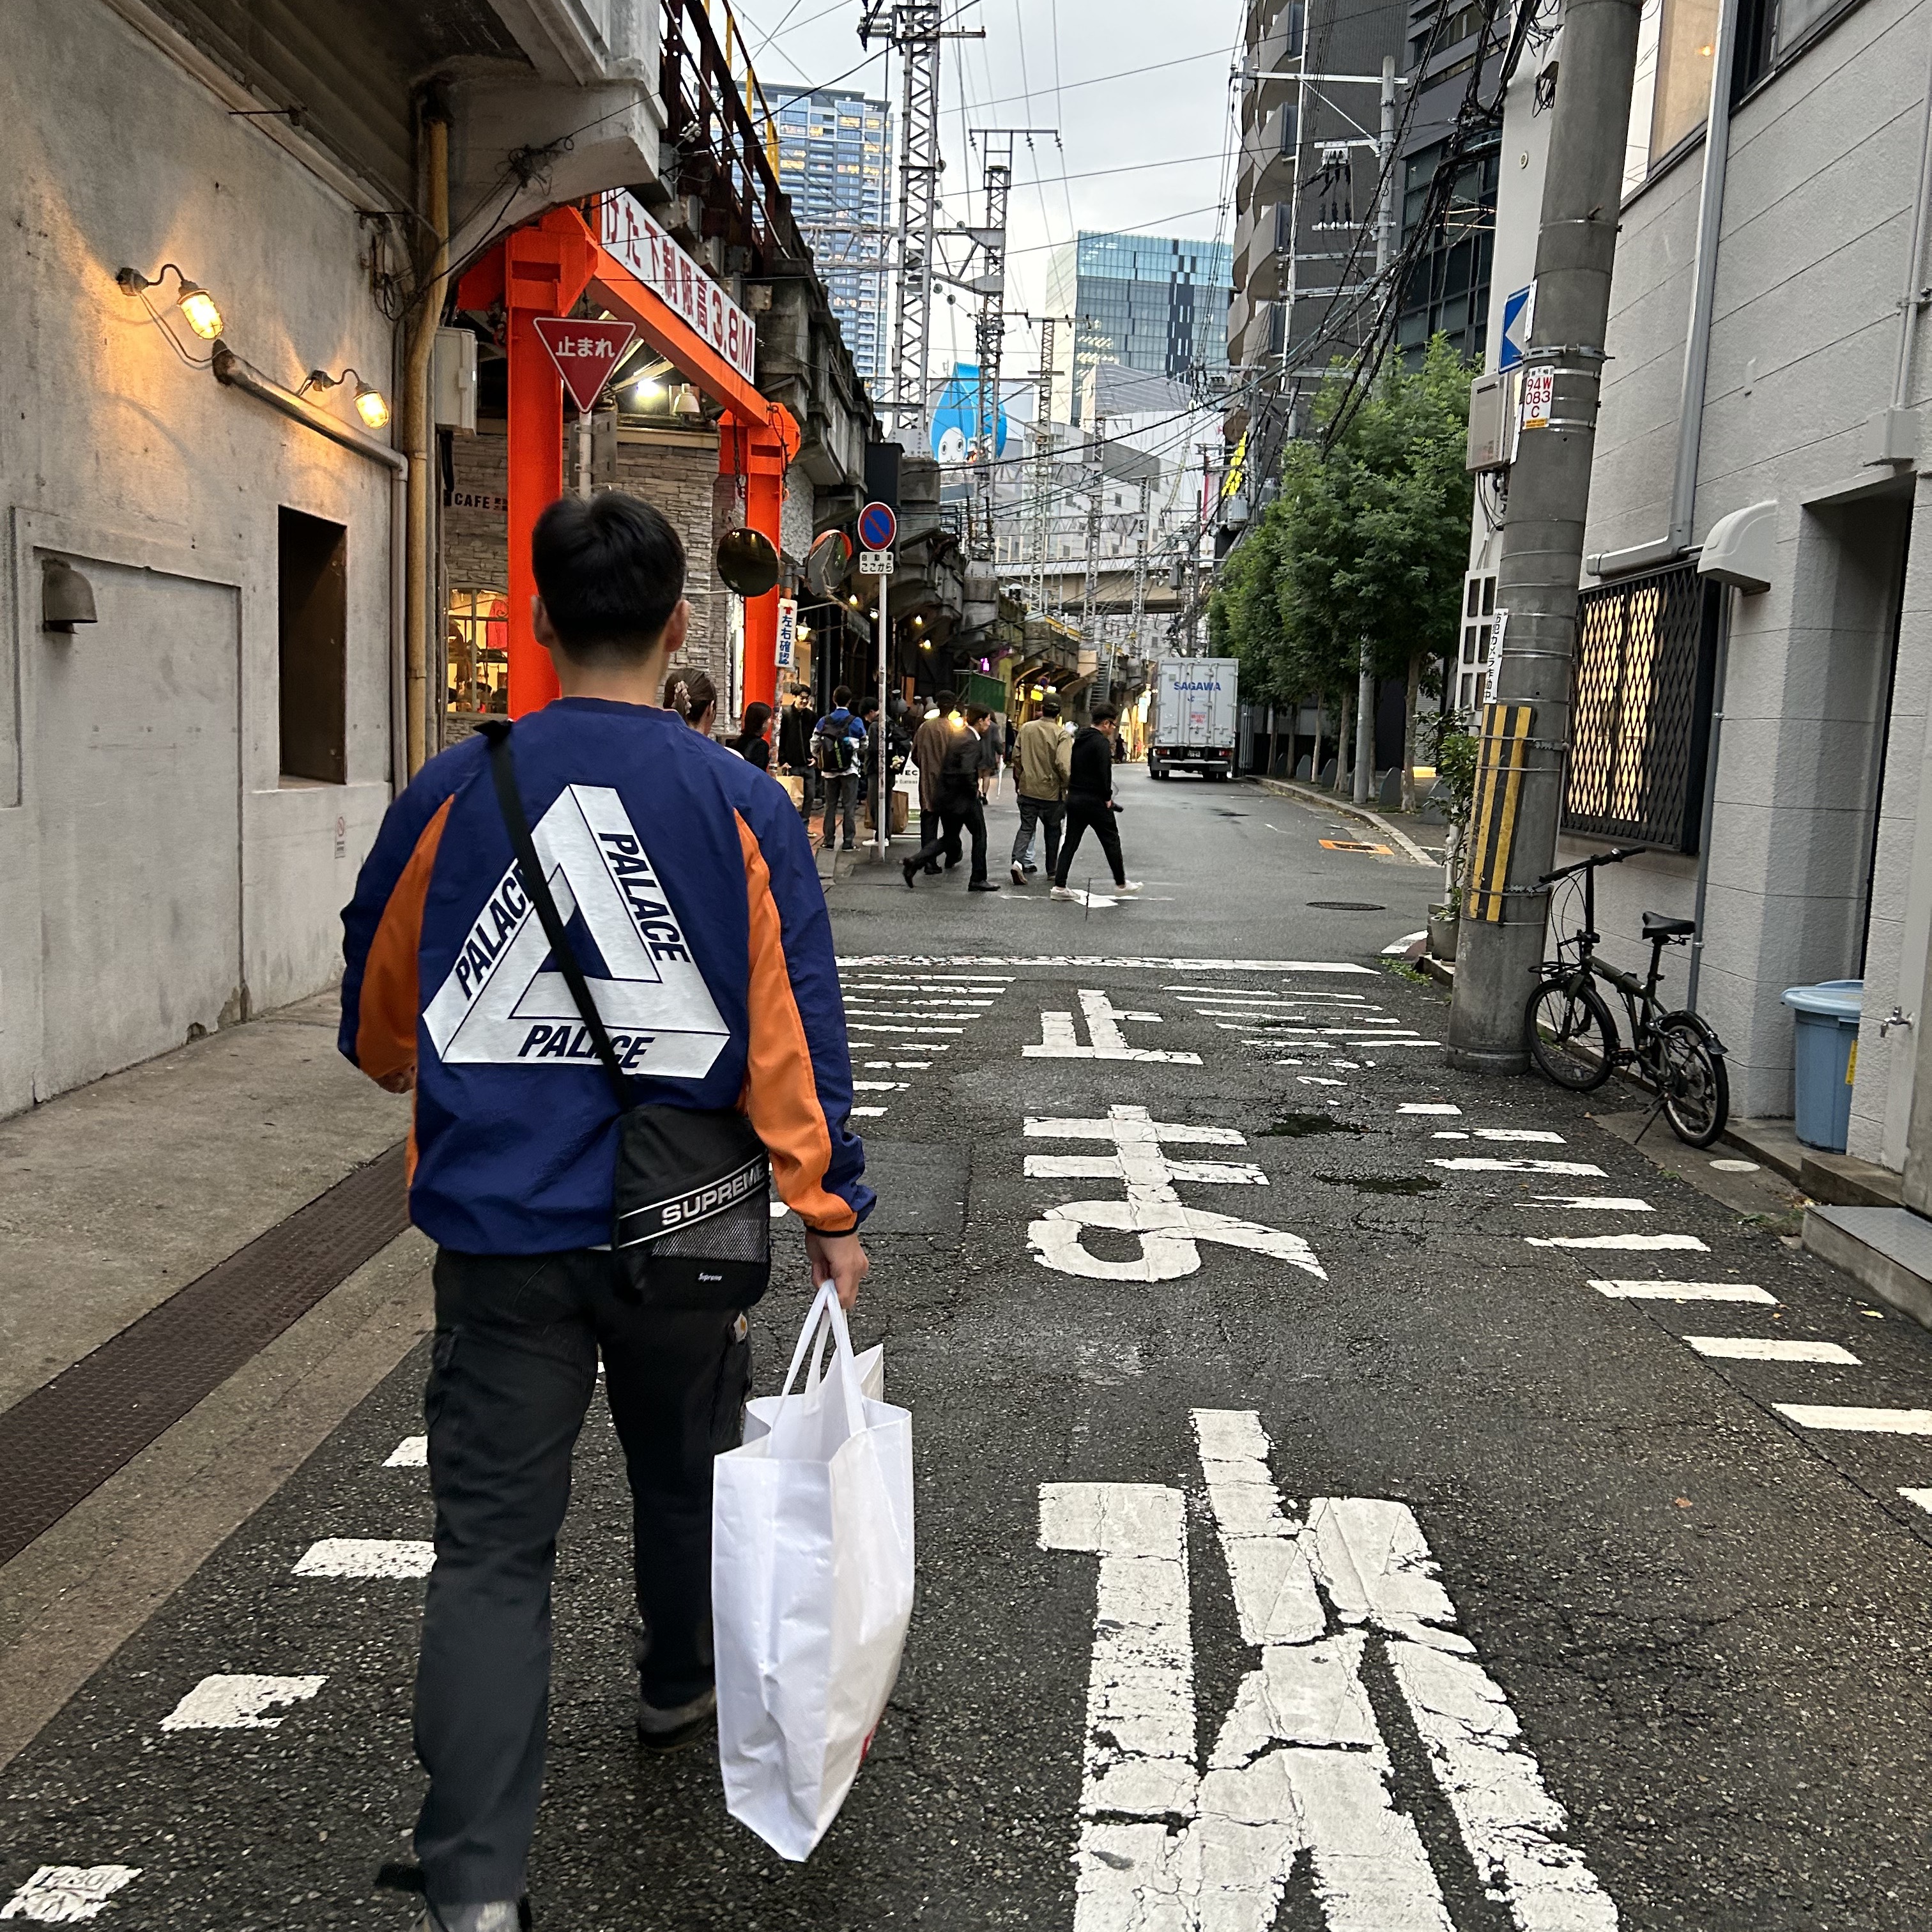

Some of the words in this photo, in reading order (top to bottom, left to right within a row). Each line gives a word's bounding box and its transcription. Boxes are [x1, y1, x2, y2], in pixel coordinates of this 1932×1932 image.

[555, 336, 615, 358] 止まれ
[1528, 376, 1552, 391] 94W
[1526, 390, 1551, 405] 083
[1531, 405, 1540, 418] C
[454, 493, 490, 509] CAFE
[861, 562, 893, 572] ここから
[778, 615, 793, 665] 左右確認
[1174, 681, 1222, 691] SAGAWA
[598, 832, 691, 963] PALACE
[661, 1161, 765, 1226] SUPREME
